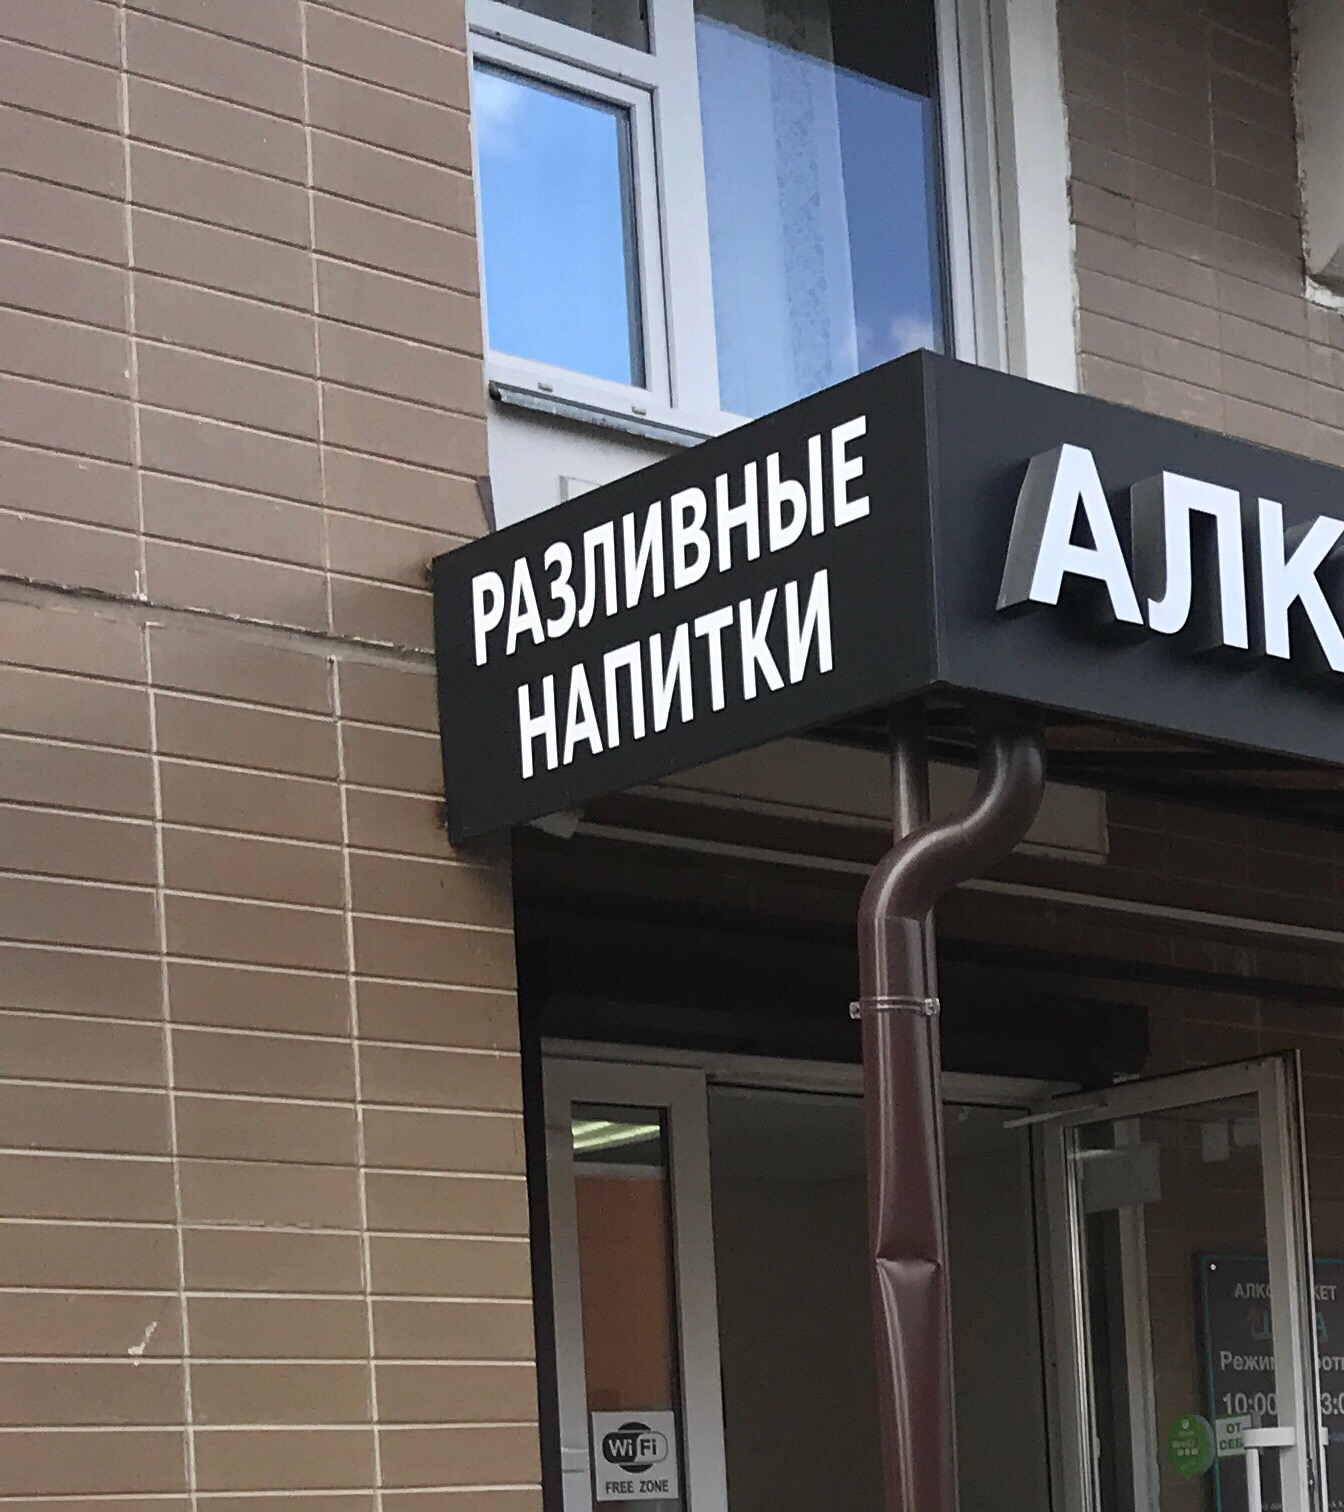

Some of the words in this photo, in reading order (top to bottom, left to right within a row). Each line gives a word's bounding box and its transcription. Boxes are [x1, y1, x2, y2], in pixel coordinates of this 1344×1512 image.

[472, 415, 870, 667] РАЗЛИВНЫЕ
[517, 569, 833, 780] НАПИТКИ
[1220, 1350, 1275, 1372] Режи
[1226, 1422, 1241, 1434] ОТ
[1219, 1437, 1244, 1451] СЕБ
[605, 1480, 635, 1494] FREE
[639, 1479, 669, 1493] ZONE
